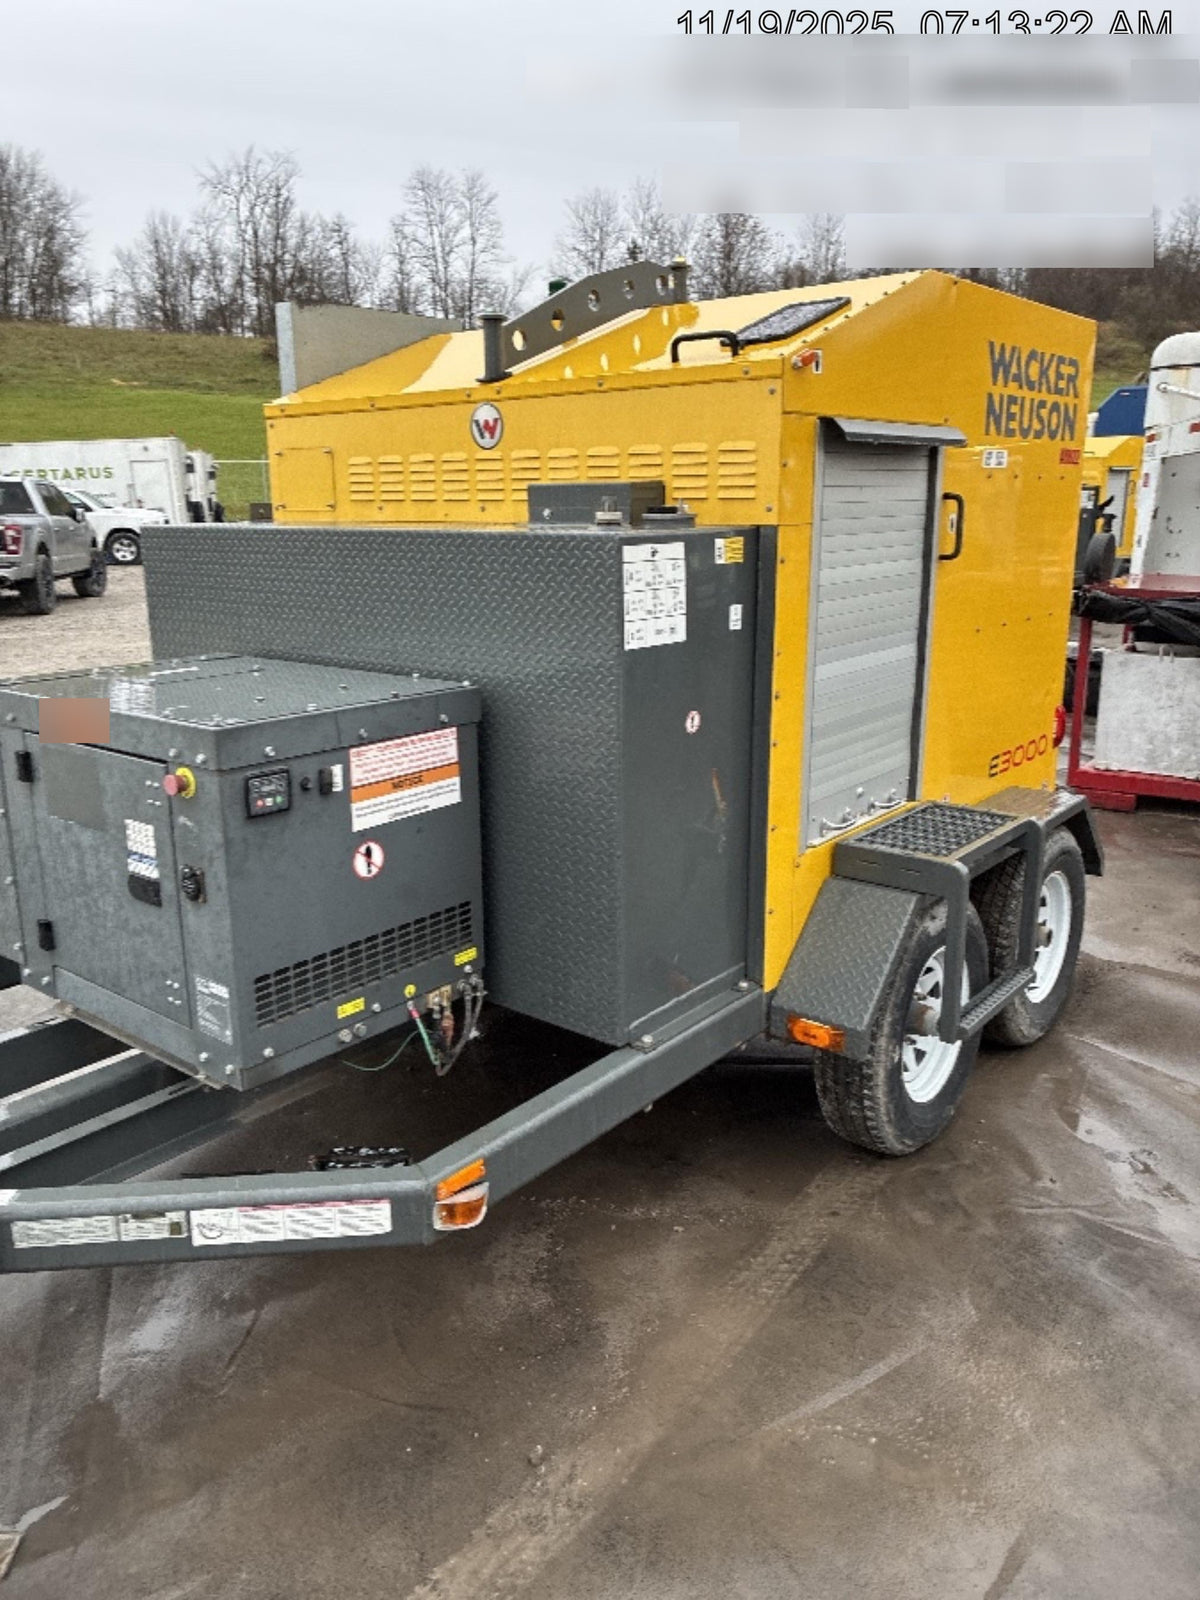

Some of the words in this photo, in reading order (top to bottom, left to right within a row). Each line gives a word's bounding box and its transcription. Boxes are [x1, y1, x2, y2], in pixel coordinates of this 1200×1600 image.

[988, 339, 1080, 398] WACKER
[984, 391, 1079, 441] NEUSON
[989, 733, 1048, 777] E3000
